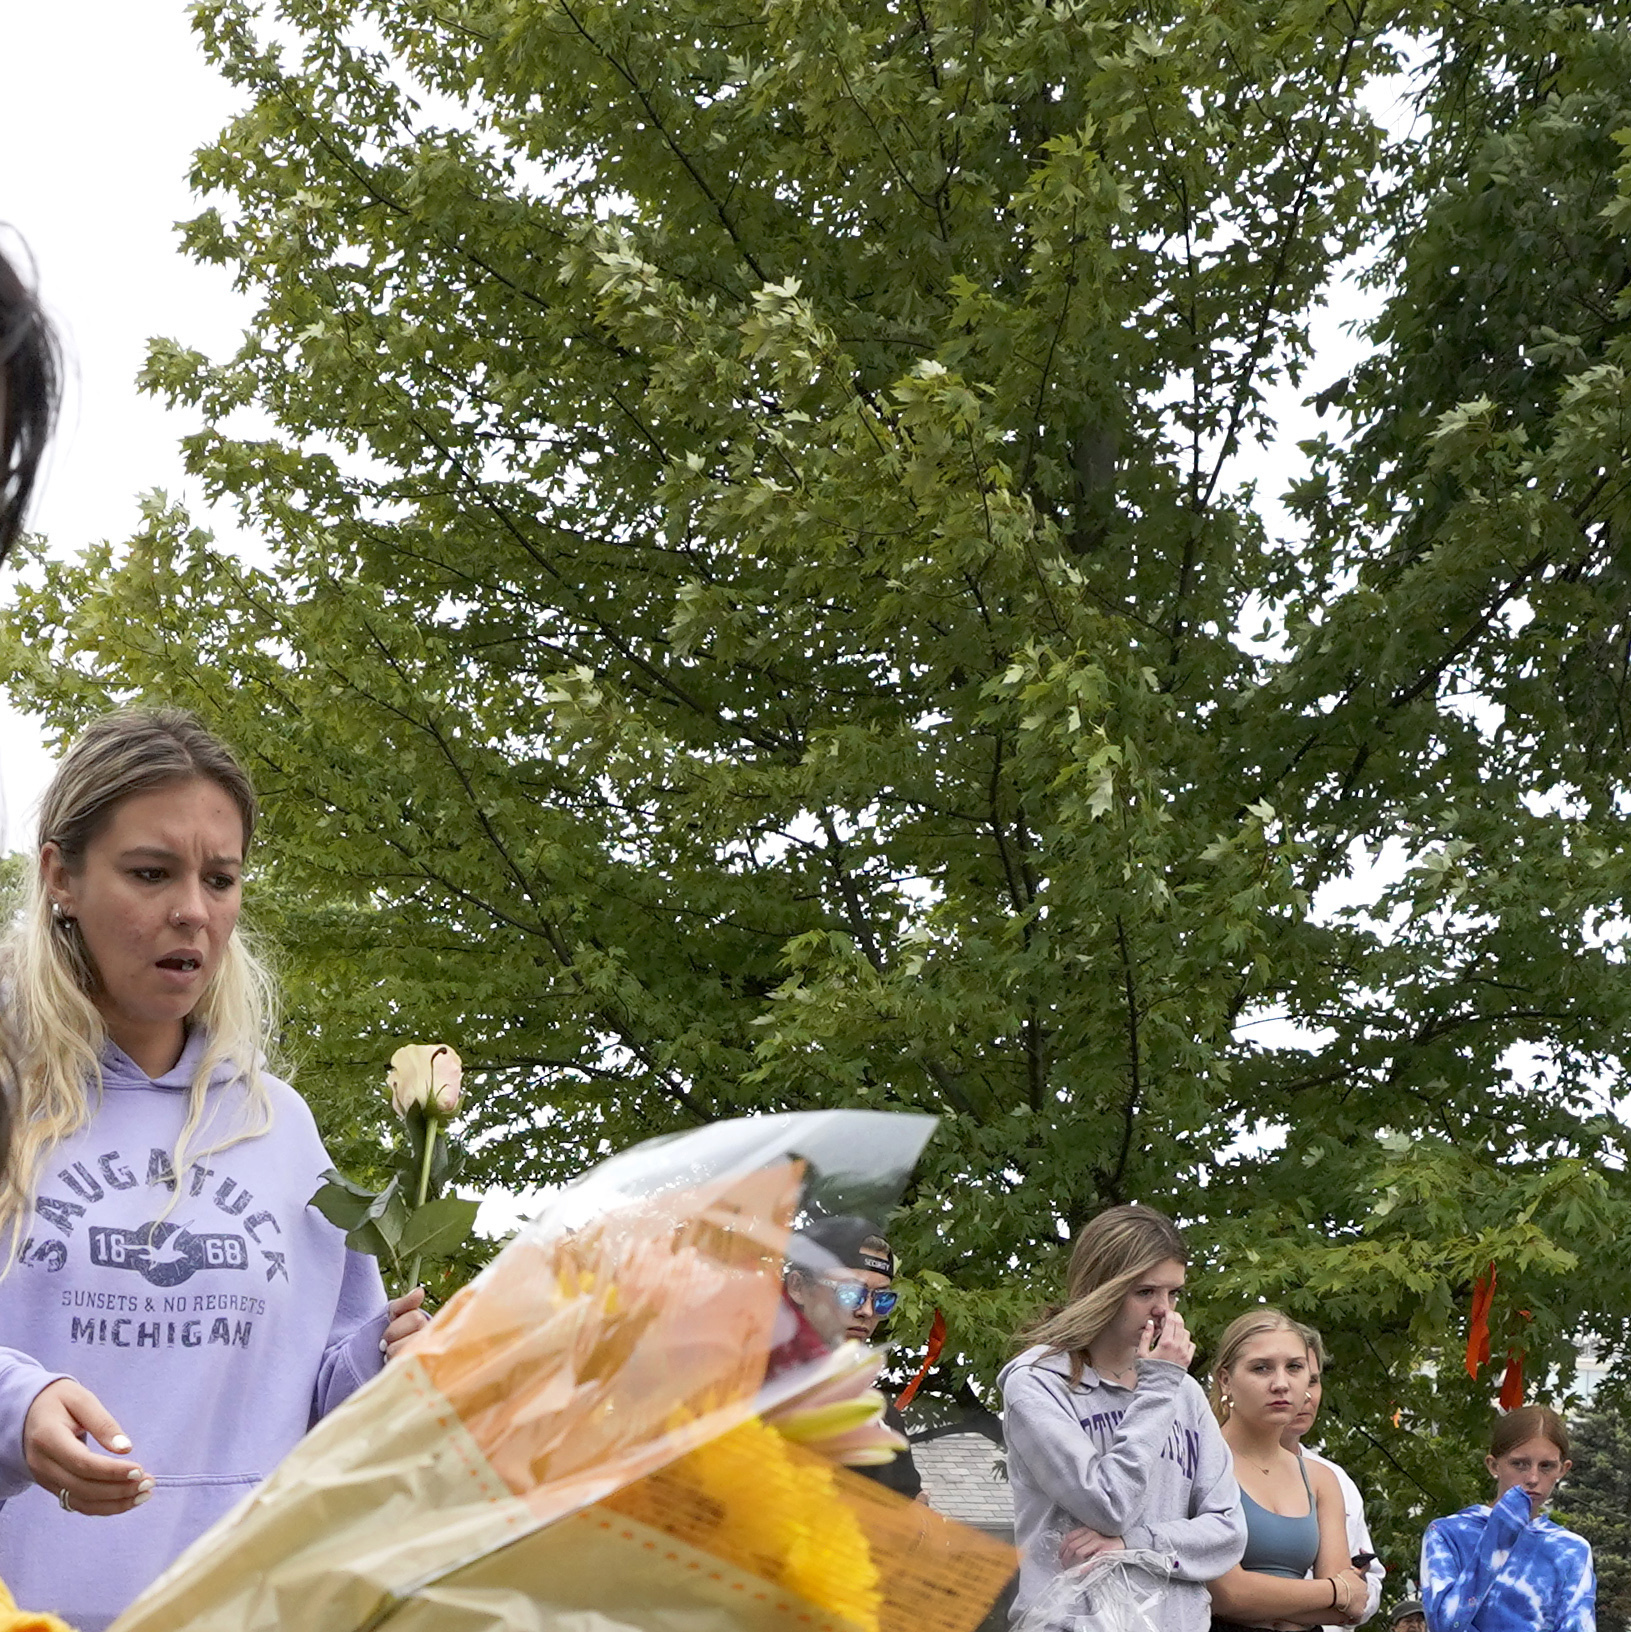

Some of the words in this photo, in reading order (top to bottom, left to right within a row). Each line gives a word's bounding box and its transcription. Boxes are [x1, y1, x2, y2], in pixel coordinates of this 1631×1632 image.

[17, 1148, 289, 1284] SAUGATUCK
[205, 1238, 242, 1264] 68
[61, 1290, 138, 1312] SUNSETS
[144, 1298, 156, 1313] &
[163, 1296, 187, 1313] NO
[193, 1294, 266, 1315] REGRETS
[70, 1316, 253, 1349] MICHIGAN
